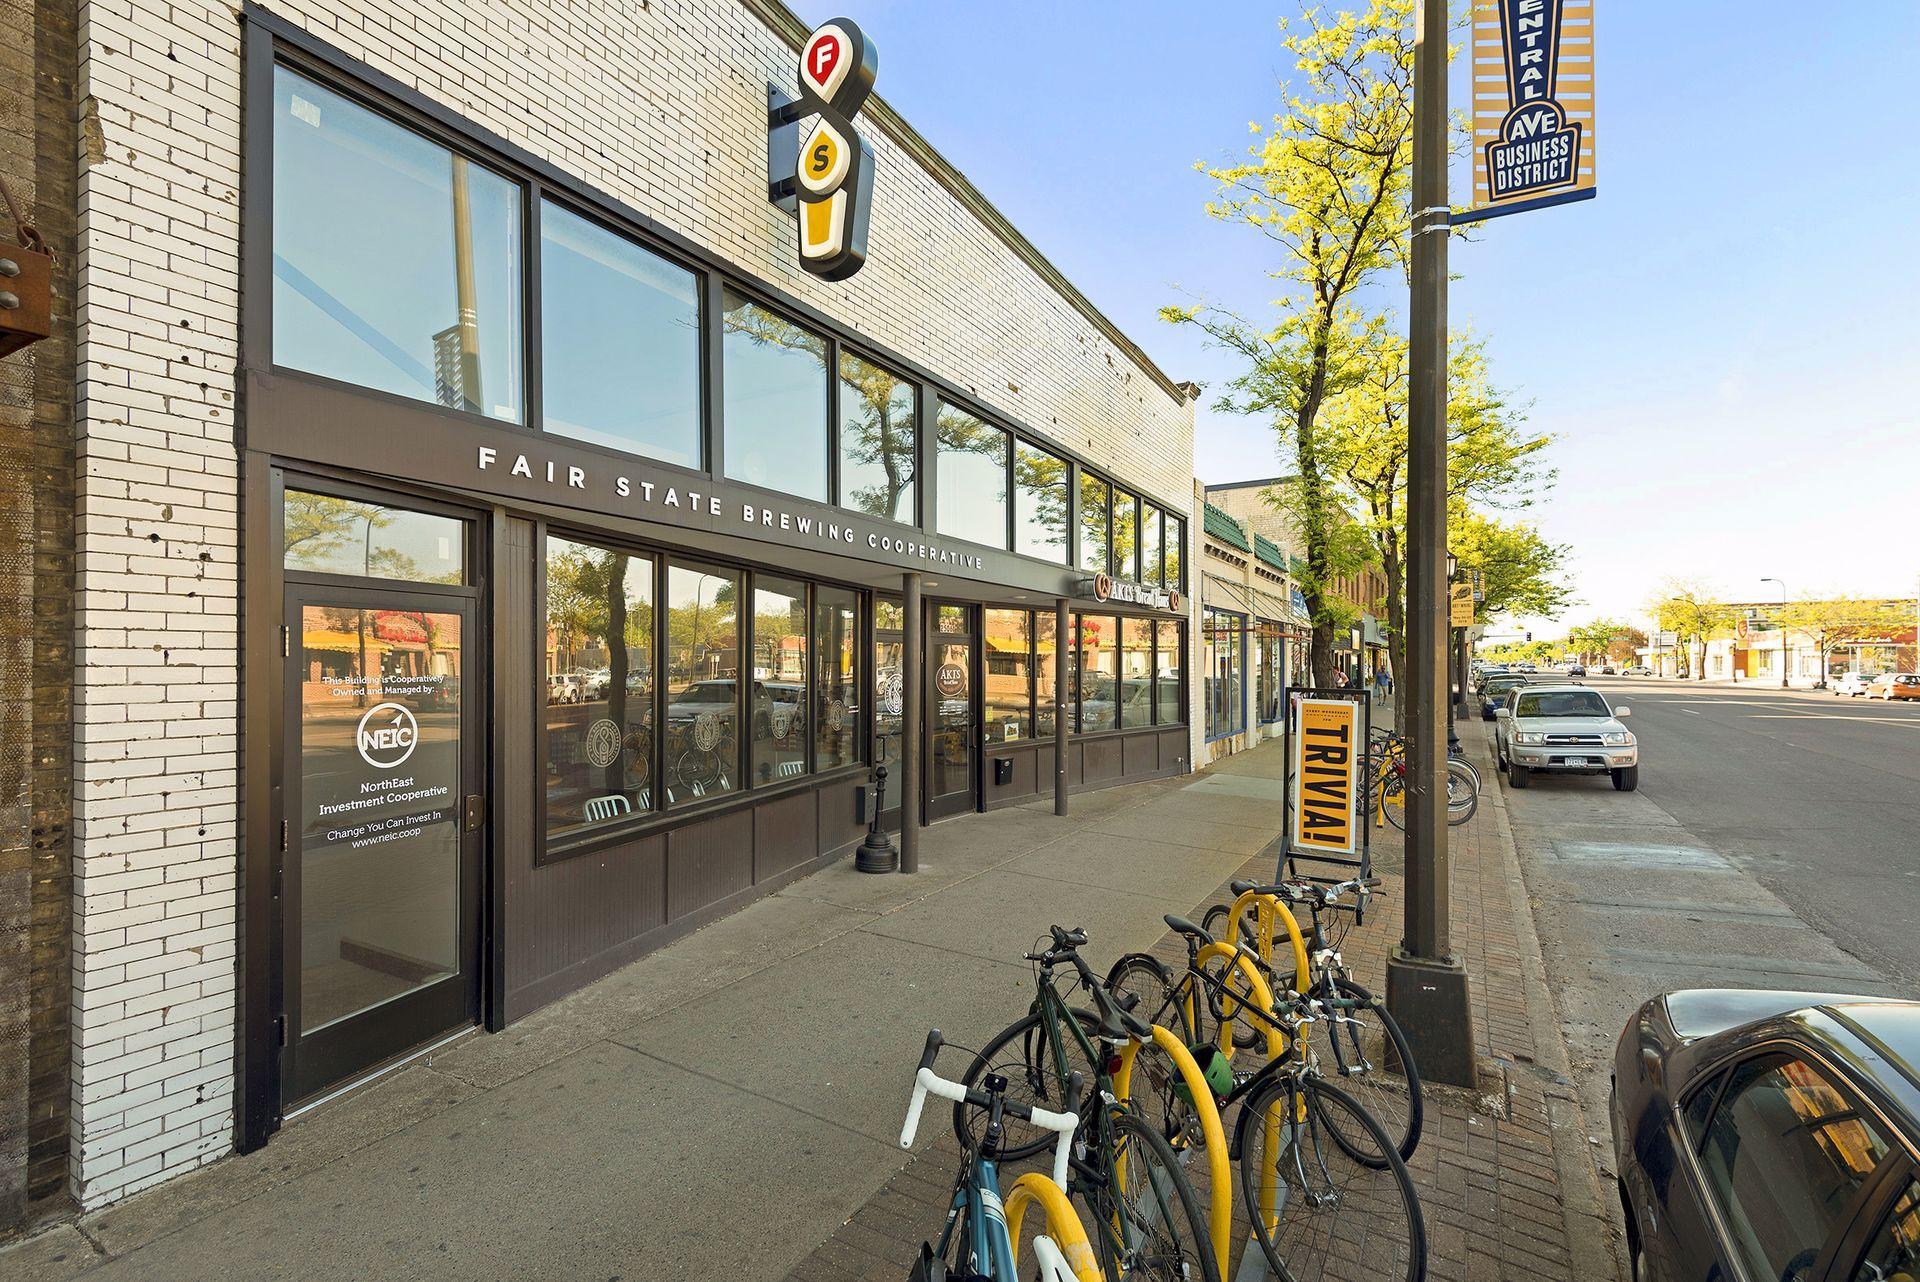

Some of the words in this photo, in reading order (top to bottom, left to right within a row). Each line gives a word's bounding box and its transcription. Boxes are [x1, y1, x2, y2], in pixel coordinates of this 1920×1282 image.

[816, 42, 834, 74] F
[1510, 110, 1556, 141] AVE
[813, 144, 830, 172] S
[1496, 135, 1569, 169] BUSINESS
[1497, 157, 1568, 191] DISTRICT
[478, 446, 586, 489] FAIR
[615, 476, 722, 516] STATE
[742, 504, 854, 543] BREWING
[867, 533, 982, 570] COOPERATIVE
[322, 676, 343, 685] This
[345, 675, 380, 686] Building
[382, 675, 389, 684] is
[390, 674, 444, 684] Cooperatively
[332, 688, 365, 696] Owned
[367, 687, 383, 695] and
[385, 686, 421, 696] Managed
[423, 685, 435, 695] by:
[362, 728, 412, 751] NEIC
[360, 777, 414, 794] NorthEast
[1303, 724, 1349, 844] TRIVIA!
[319, 795, 385, 815] Investment
[386, 786, 448, 803] Cooperative
[327, 827, 365, 841] Change
[367, 822, 385, 833] You
[386, 819, 405, 829] Can
[406, 813, 432, 825] Invest
[433, 811, 442, 819] In
[351, 827, 421, 848] www.neic.coop
